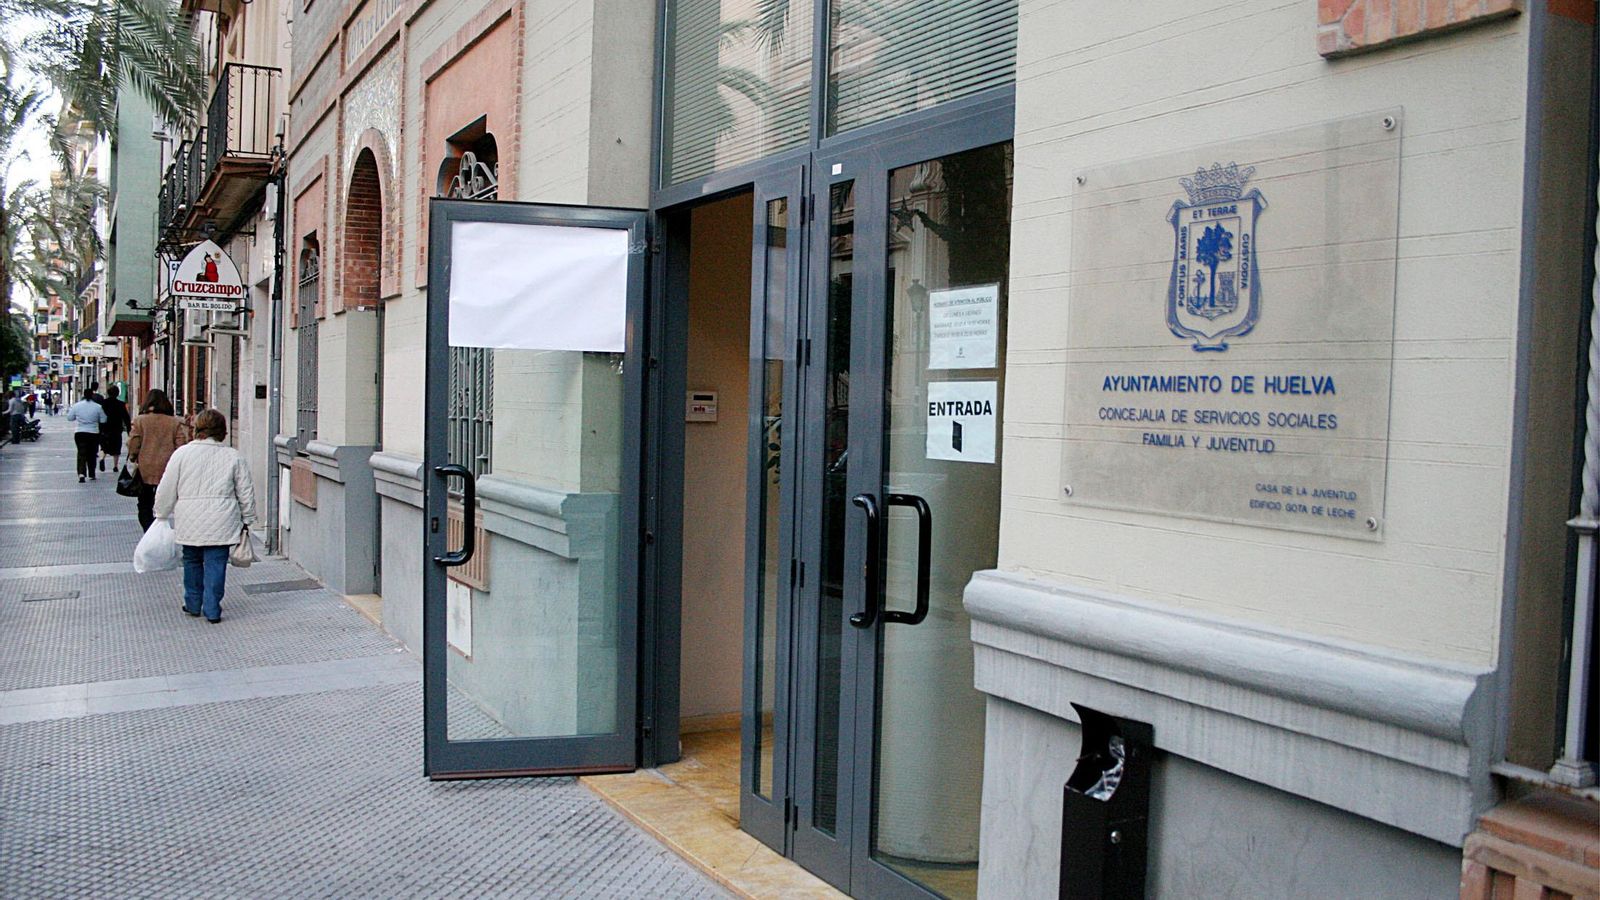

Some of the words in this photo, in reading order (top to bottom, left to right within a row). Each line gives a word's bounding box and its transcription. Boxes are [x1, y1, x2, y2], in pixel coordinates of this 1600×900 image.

[1193, 209, 1204, 219] ET
[1179, 226, 1187, 261] MARIS
[1241, 233, 1250, 289] CUSTODIA
[174, 280, 242, 297] Cruzcampo
[1178, 264, 1186, 307] PORTUS
[1103, 375, 1223, 394] AYUNTAMIENTO
[1231, 375, 1255, 394] DE
[1264, 375, 1336, 396] HUELVA
[928, 400, 993, 417] ENTRADA
[1098, 407, 1166, 423] CONCEJALIA
[1171, 409, 1188, 424] DE
[1194, 410, 1261, 427] SERVICIOS
[1267, 412, 1338, 430] SOCIALES
[1142, 432, 1186, 448] FAMILIA
[1192, 436, 1200, 448] Y
[1206, 437, 1275, 453] JUVENTUD
[1256, 483, 1278, 493] CASA
[1281, 485, 1293, 495] DE
[1296, 487, 1308, 496] LA
[1311, 488, 1357, 501] JUVENTUD
[1250, 499, 1281, 510] EDIFICIO
[1285, 503, 1308, 513] GOTA
[1311, 506, 1323, 515] DE
[1327, 507, 1356, 519] LECHE
